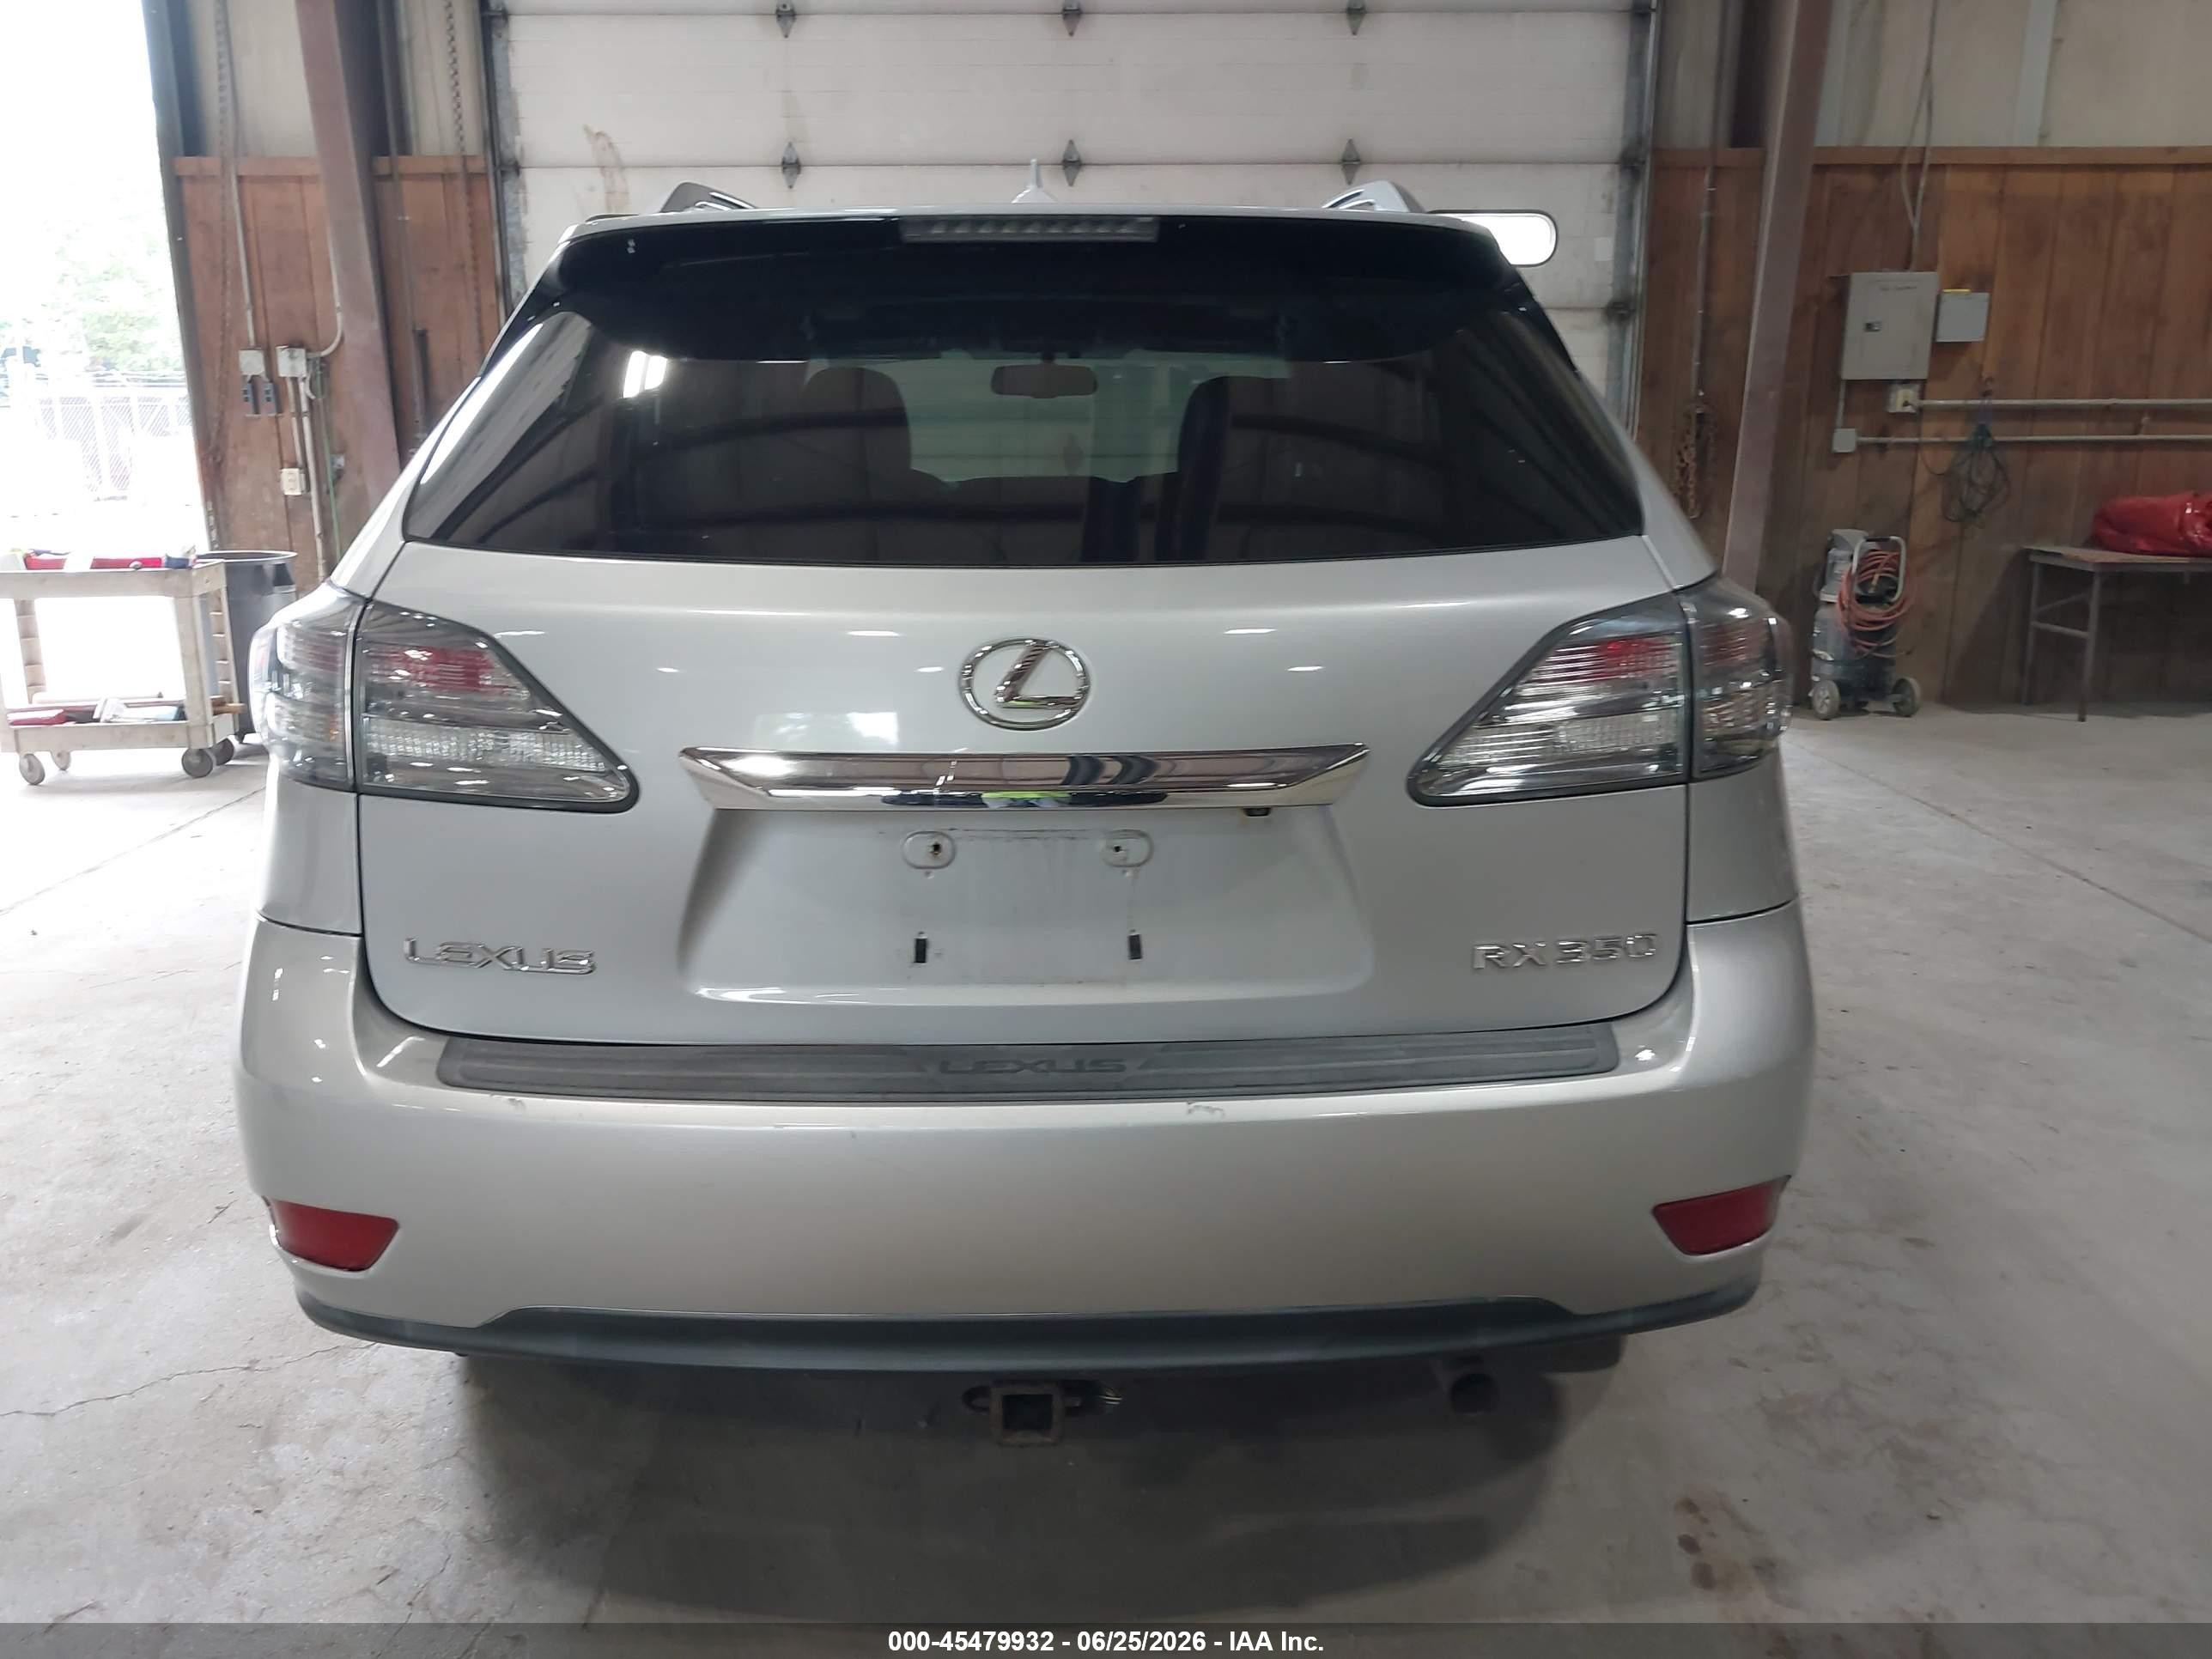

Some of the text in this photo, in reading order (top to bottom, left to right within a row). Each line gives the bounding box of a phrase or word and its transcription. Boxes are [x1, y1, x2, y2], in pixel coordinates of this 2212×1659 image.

[404, 937, 595, 975] LEXUS
[1472, 933, 1656, 969] RX 350
[939, 1059, 1127, 1074] LEXUS
